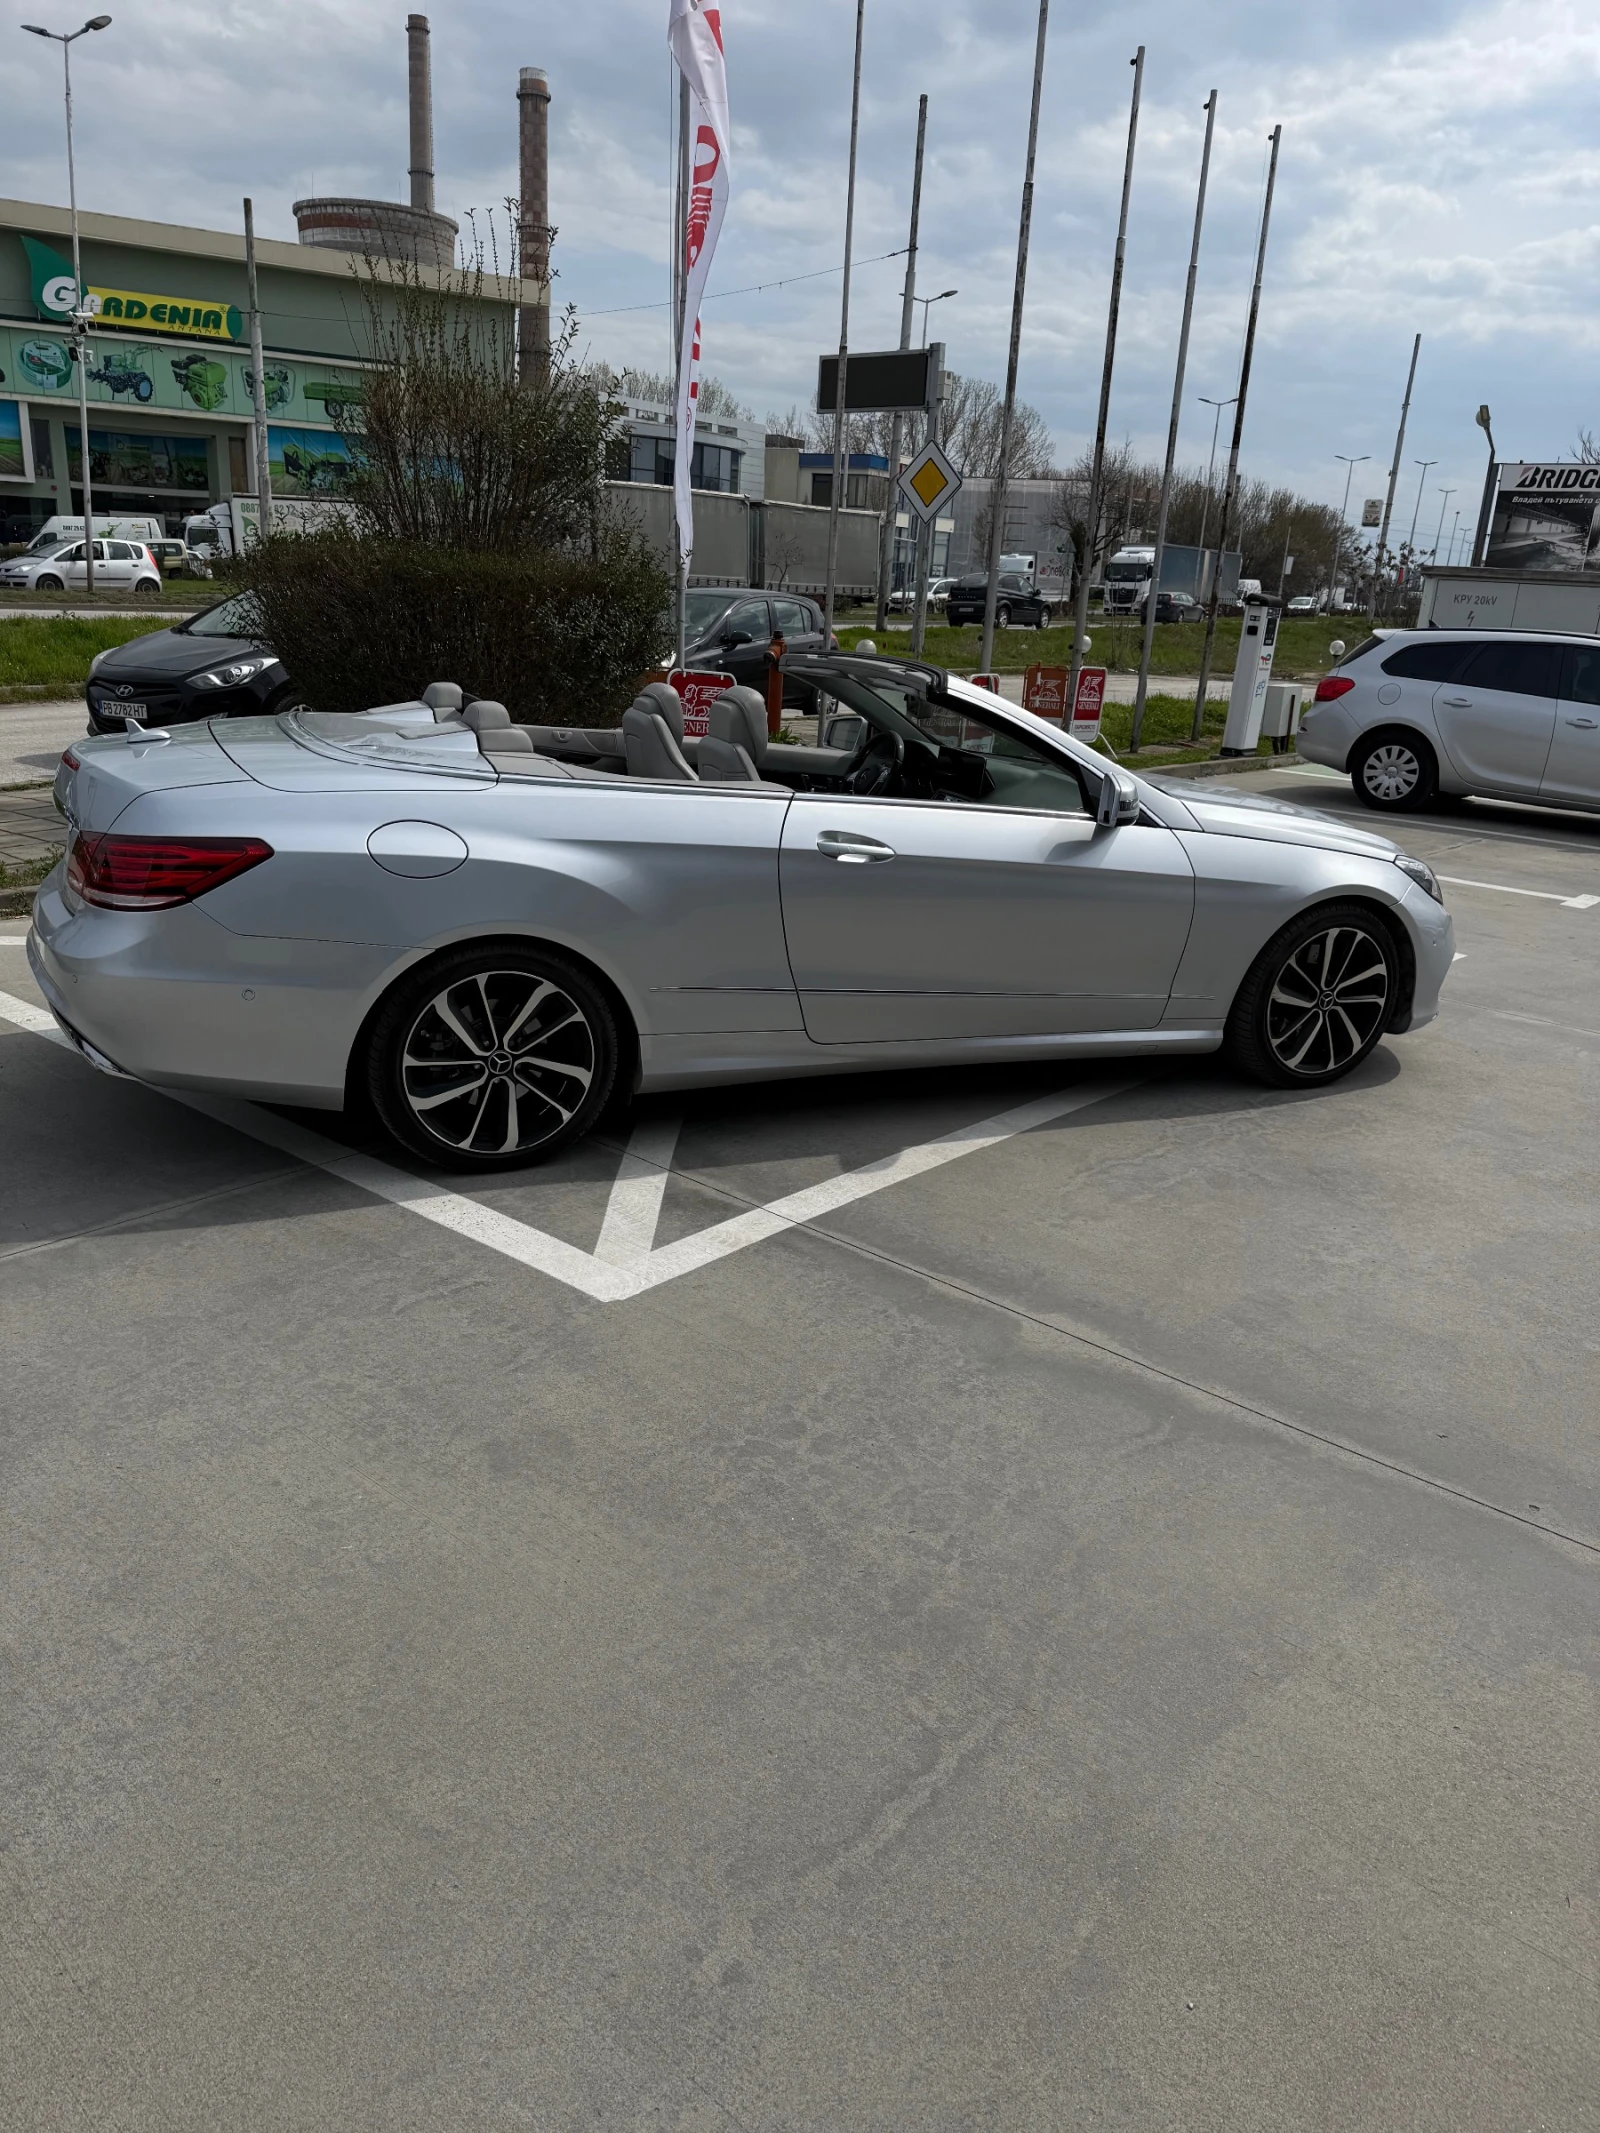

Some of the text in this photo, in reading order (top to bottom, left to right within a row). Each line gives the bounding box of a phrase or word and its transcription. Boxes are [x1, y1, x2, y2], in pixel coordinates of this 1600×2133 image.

[42, 276, 222, 329] GARDENIA
[168, 324, 222, 336] ANTANA
[1511, 496, 1544, 505] Владей
[1544, 497, 1594, 505] пътуването
[1474, 595, 1499, 606] 20kV
[103, 702, 144, 718] PB 2782 HT
[1028, 700, 1060, 710] GNERALI
[1077, 701, 1100, 710] GENERALI
